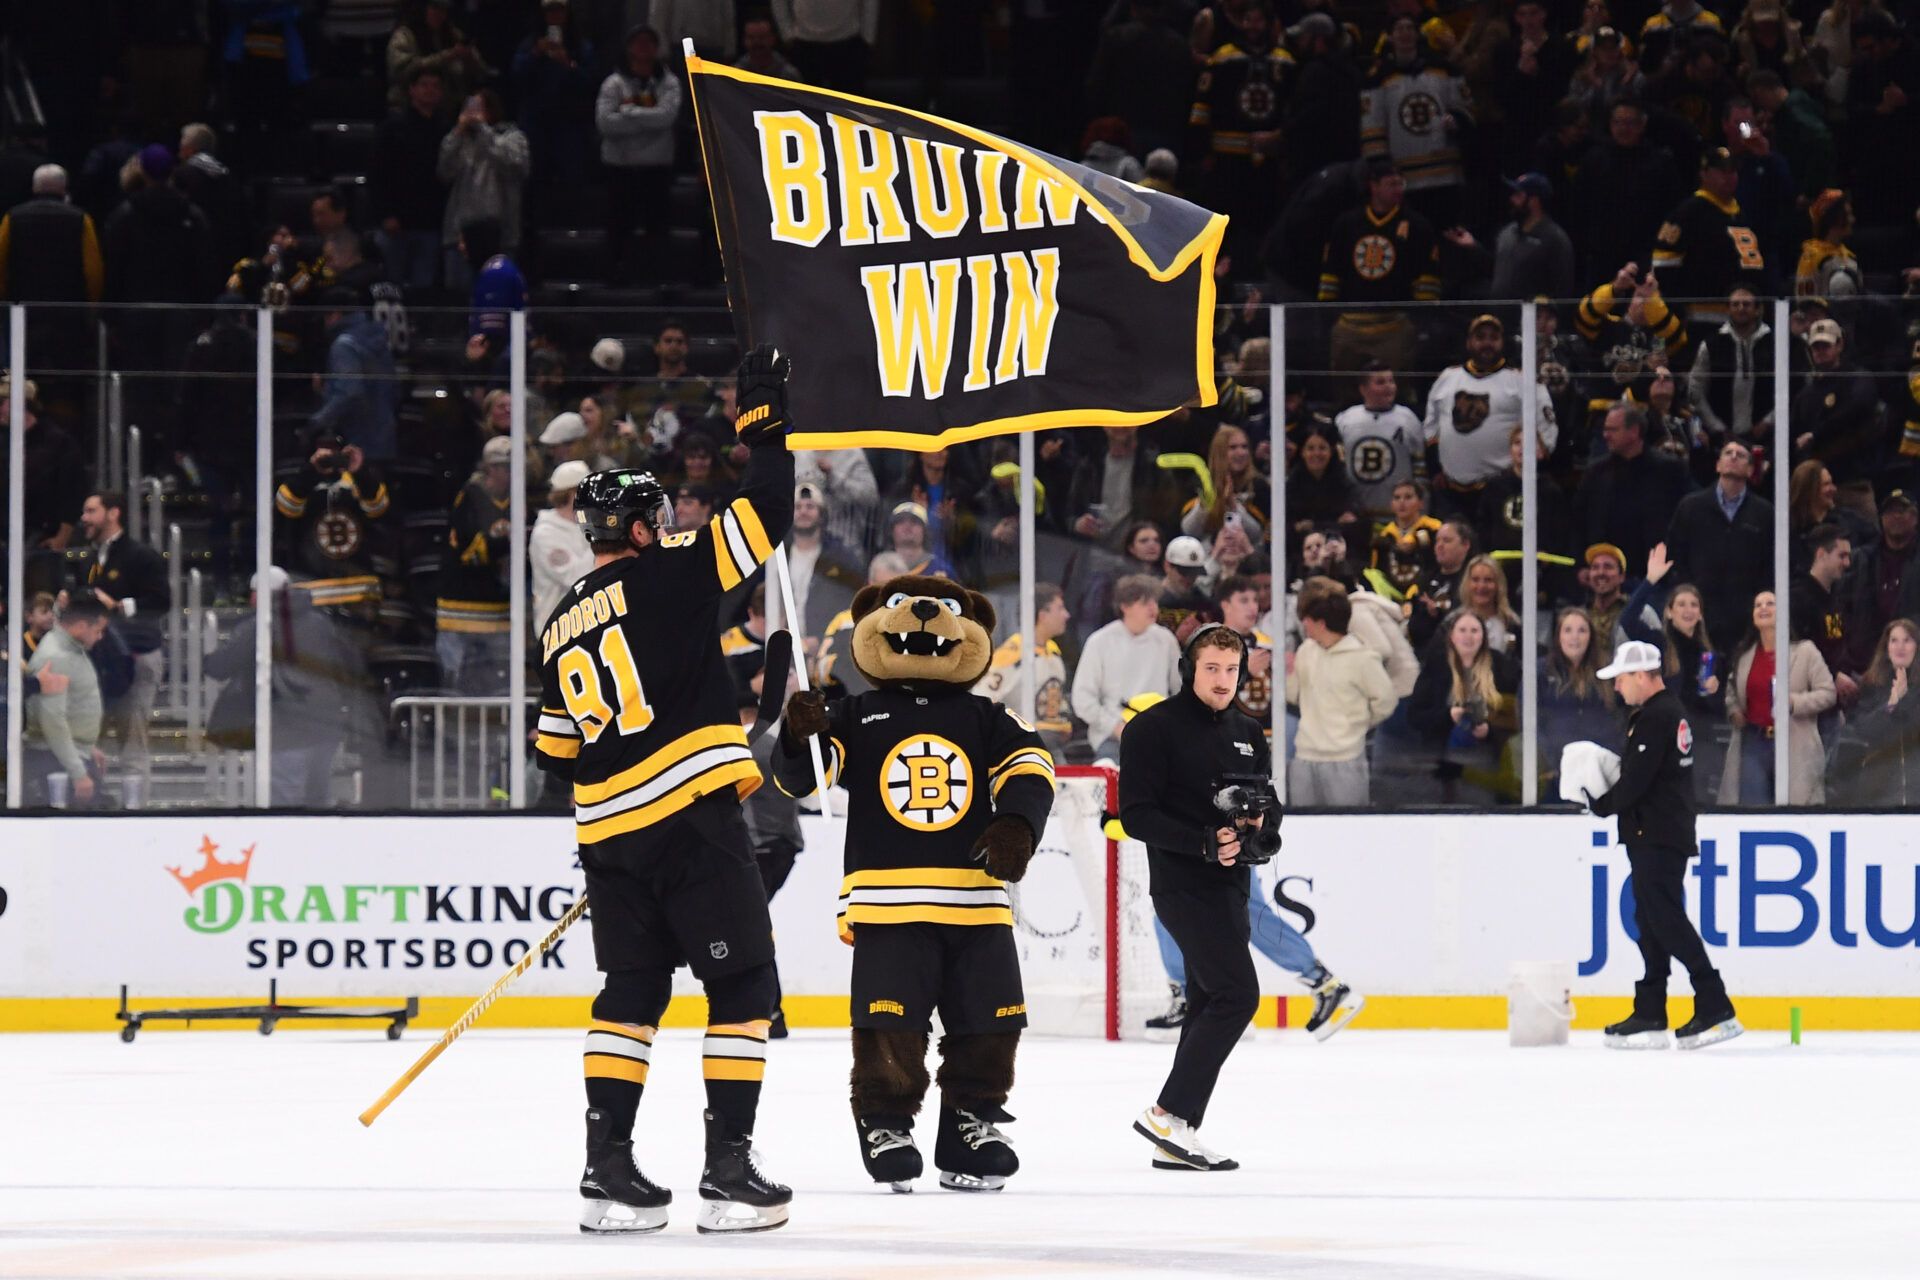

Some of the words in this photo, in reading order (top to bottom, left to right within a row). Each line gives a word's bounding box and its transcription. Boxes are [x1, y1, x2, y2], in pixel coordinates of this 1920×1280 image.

[860, 247, 1060, 400] WIN
[557, 624, 655, 747] 91
[906, 755, 951, 809] B
[246, 938, 566, 969] SPORTSBOOK
[869, 1001, 905, 1017] BRUINS
